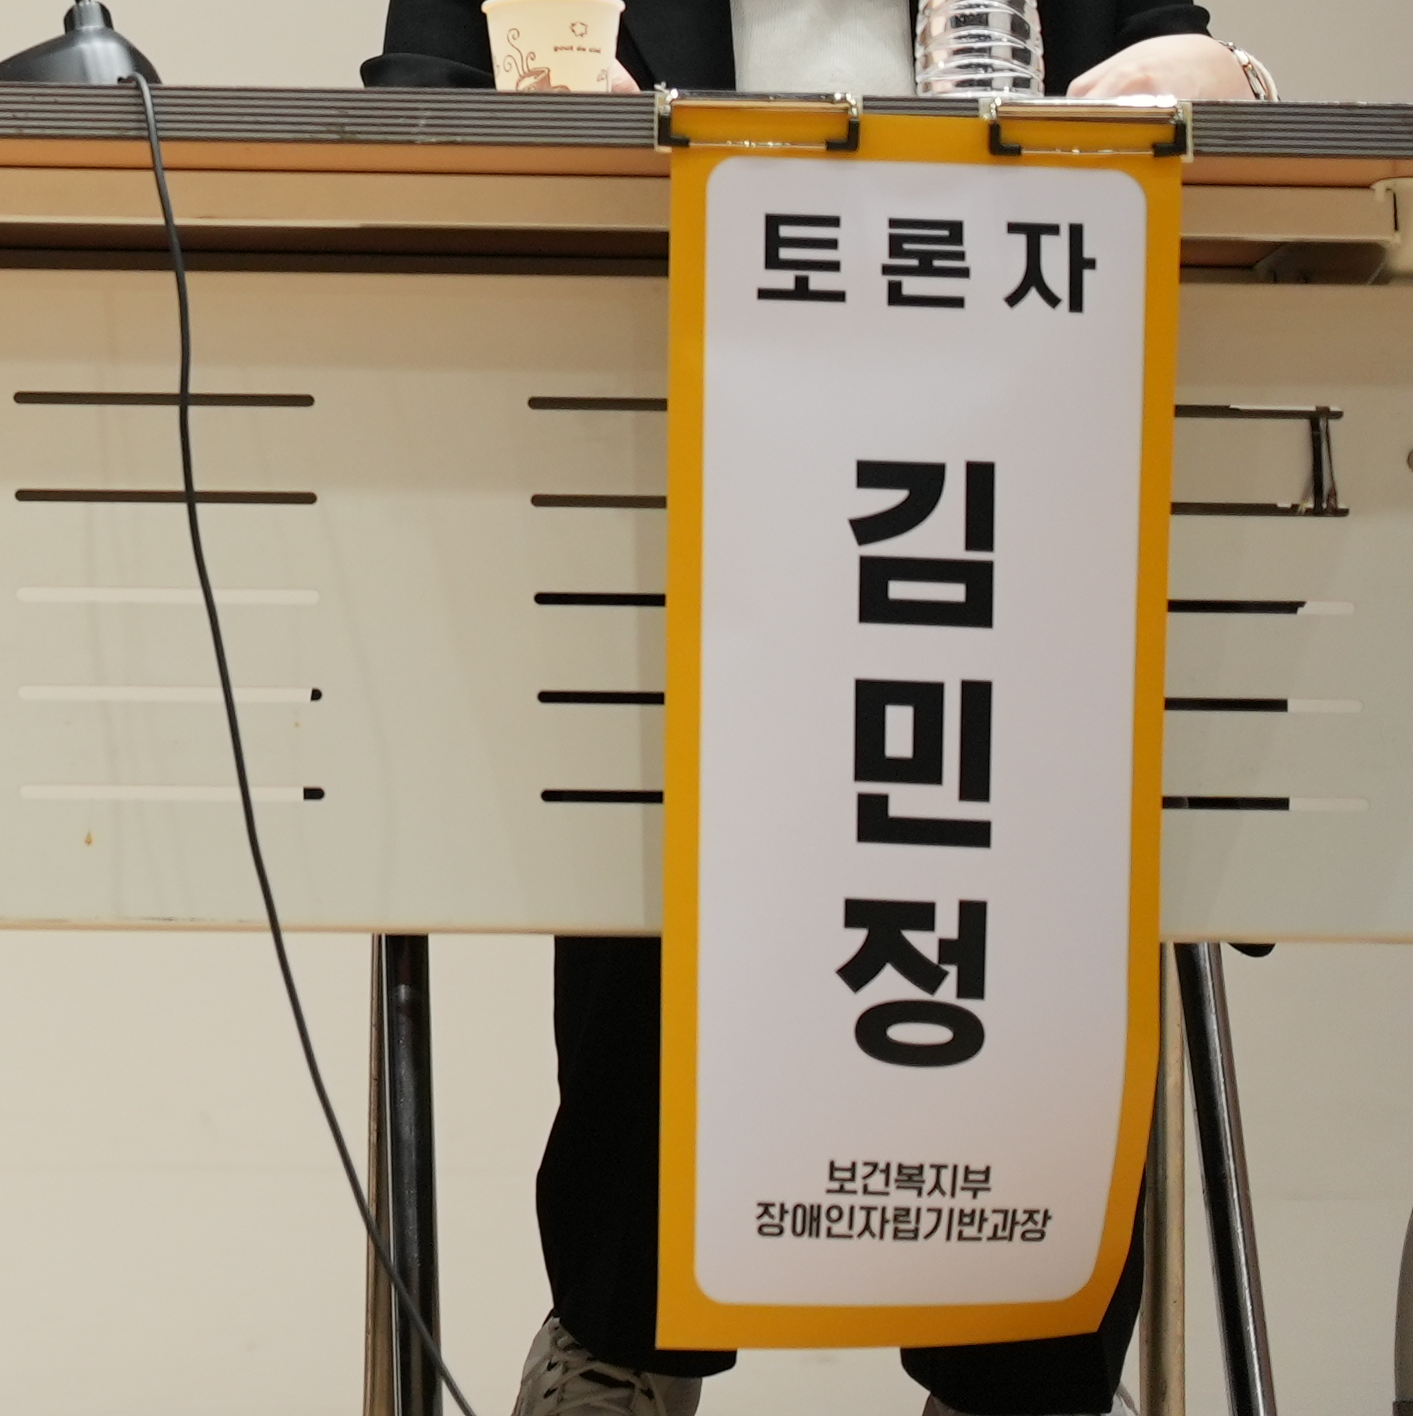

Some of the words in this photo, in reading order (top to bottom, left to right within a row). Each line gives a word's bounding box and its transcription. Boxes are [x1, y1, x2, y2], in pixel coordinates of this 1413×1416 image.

[756, 212, 1097, 314] 토론자
[835, 459, 996, 1068] 김민정
[825, 1159, 992, 1200] 보건복지부
[755, 1200, 1053, 1243] 장애인자립기반과장
